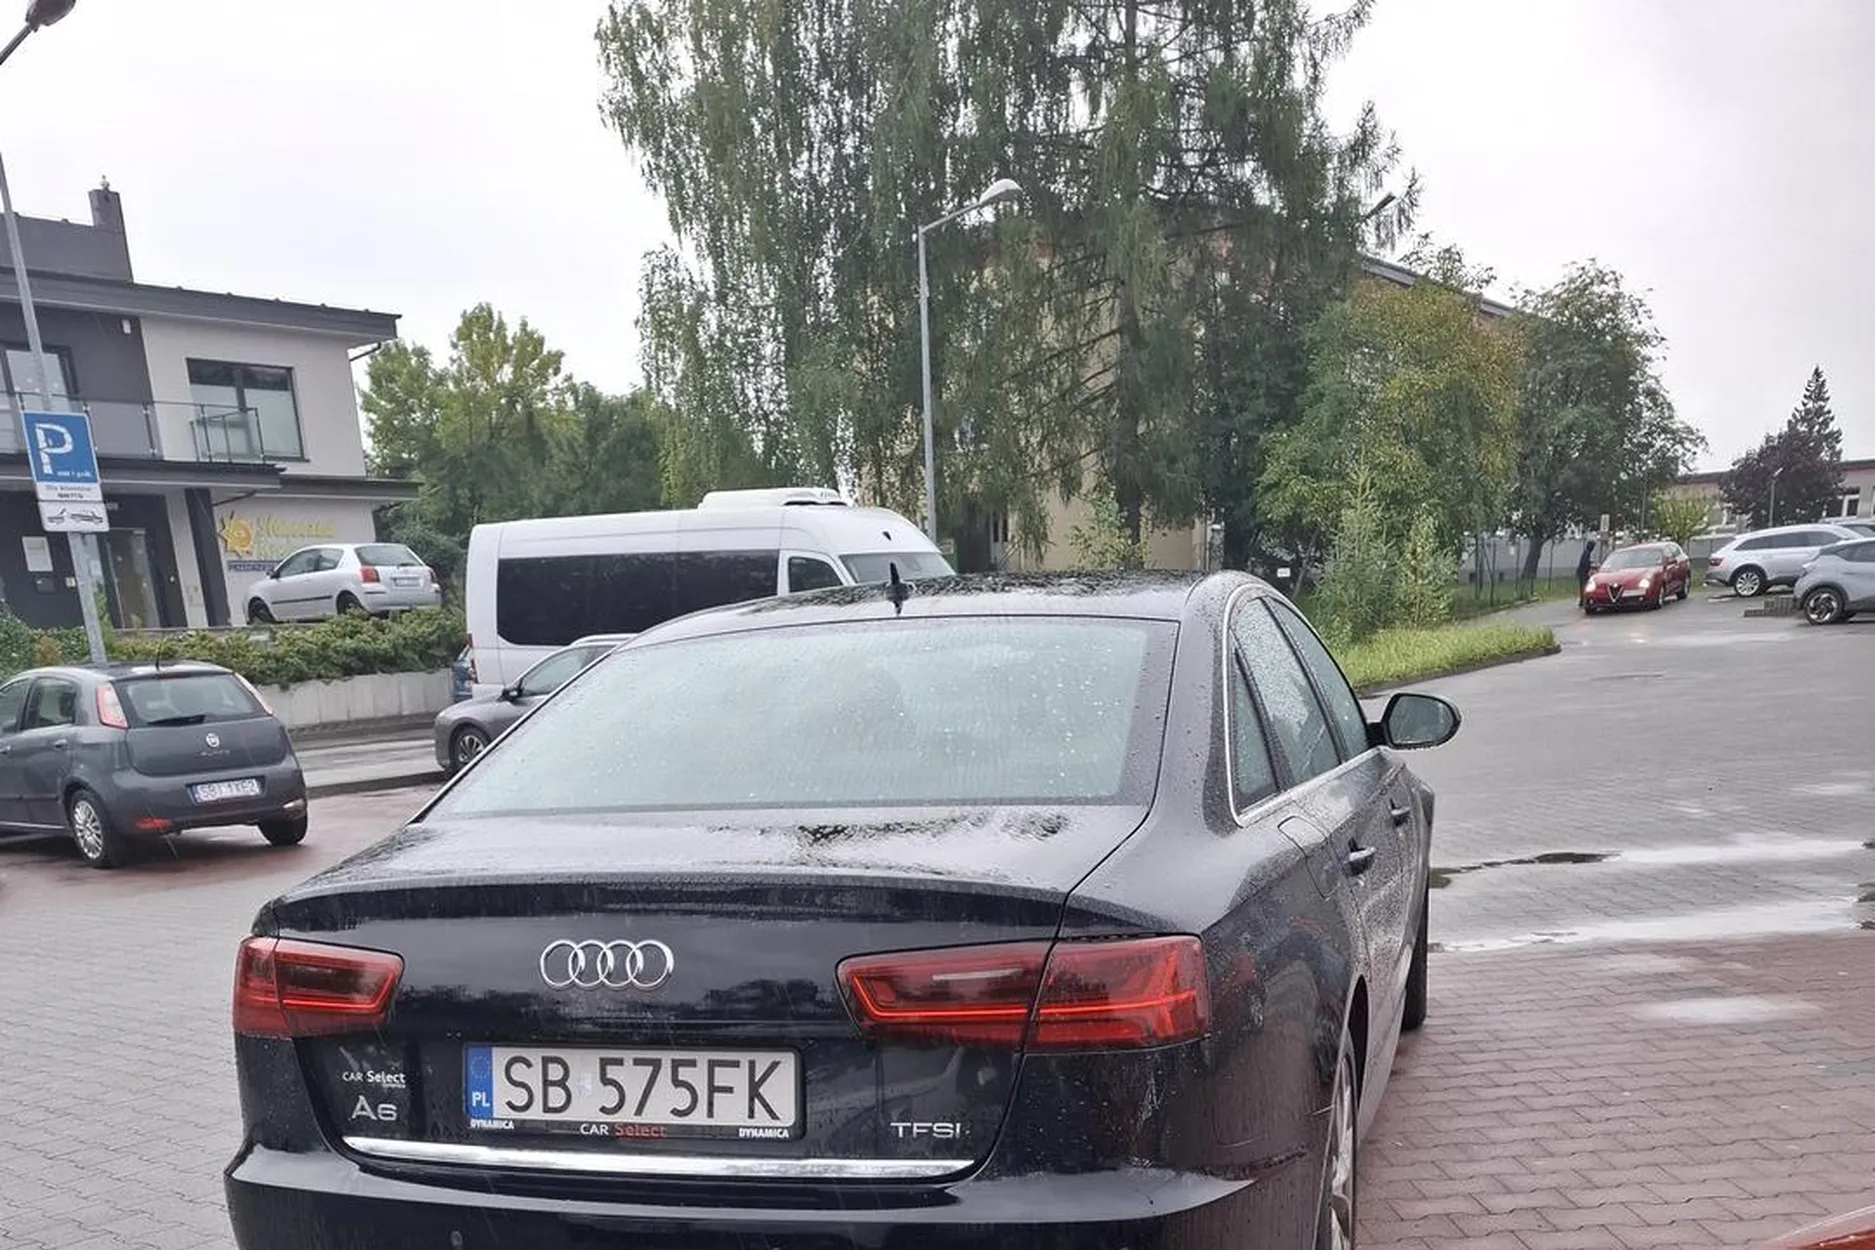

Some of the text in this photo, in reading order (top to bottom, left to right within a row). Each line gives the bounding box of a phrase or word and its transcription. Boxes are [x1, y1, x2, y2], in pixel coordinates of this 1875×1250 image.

[36, 423, 73, 475] P
[342, 1070, 406, 1083] CAR Select
[504, 1055, 782, 1121] SB 575FK
[472, 1092, 490, 1107] PL
[351, 1095, 398, 1121] A6
[470, 1119, 515, 1130] DYNAMICA
[580, 1123, 667, 1137] CAR Select
[890, 1122, 961, 1138] TFSI
[738, 1128, 789, 1138] DYNAMICA
